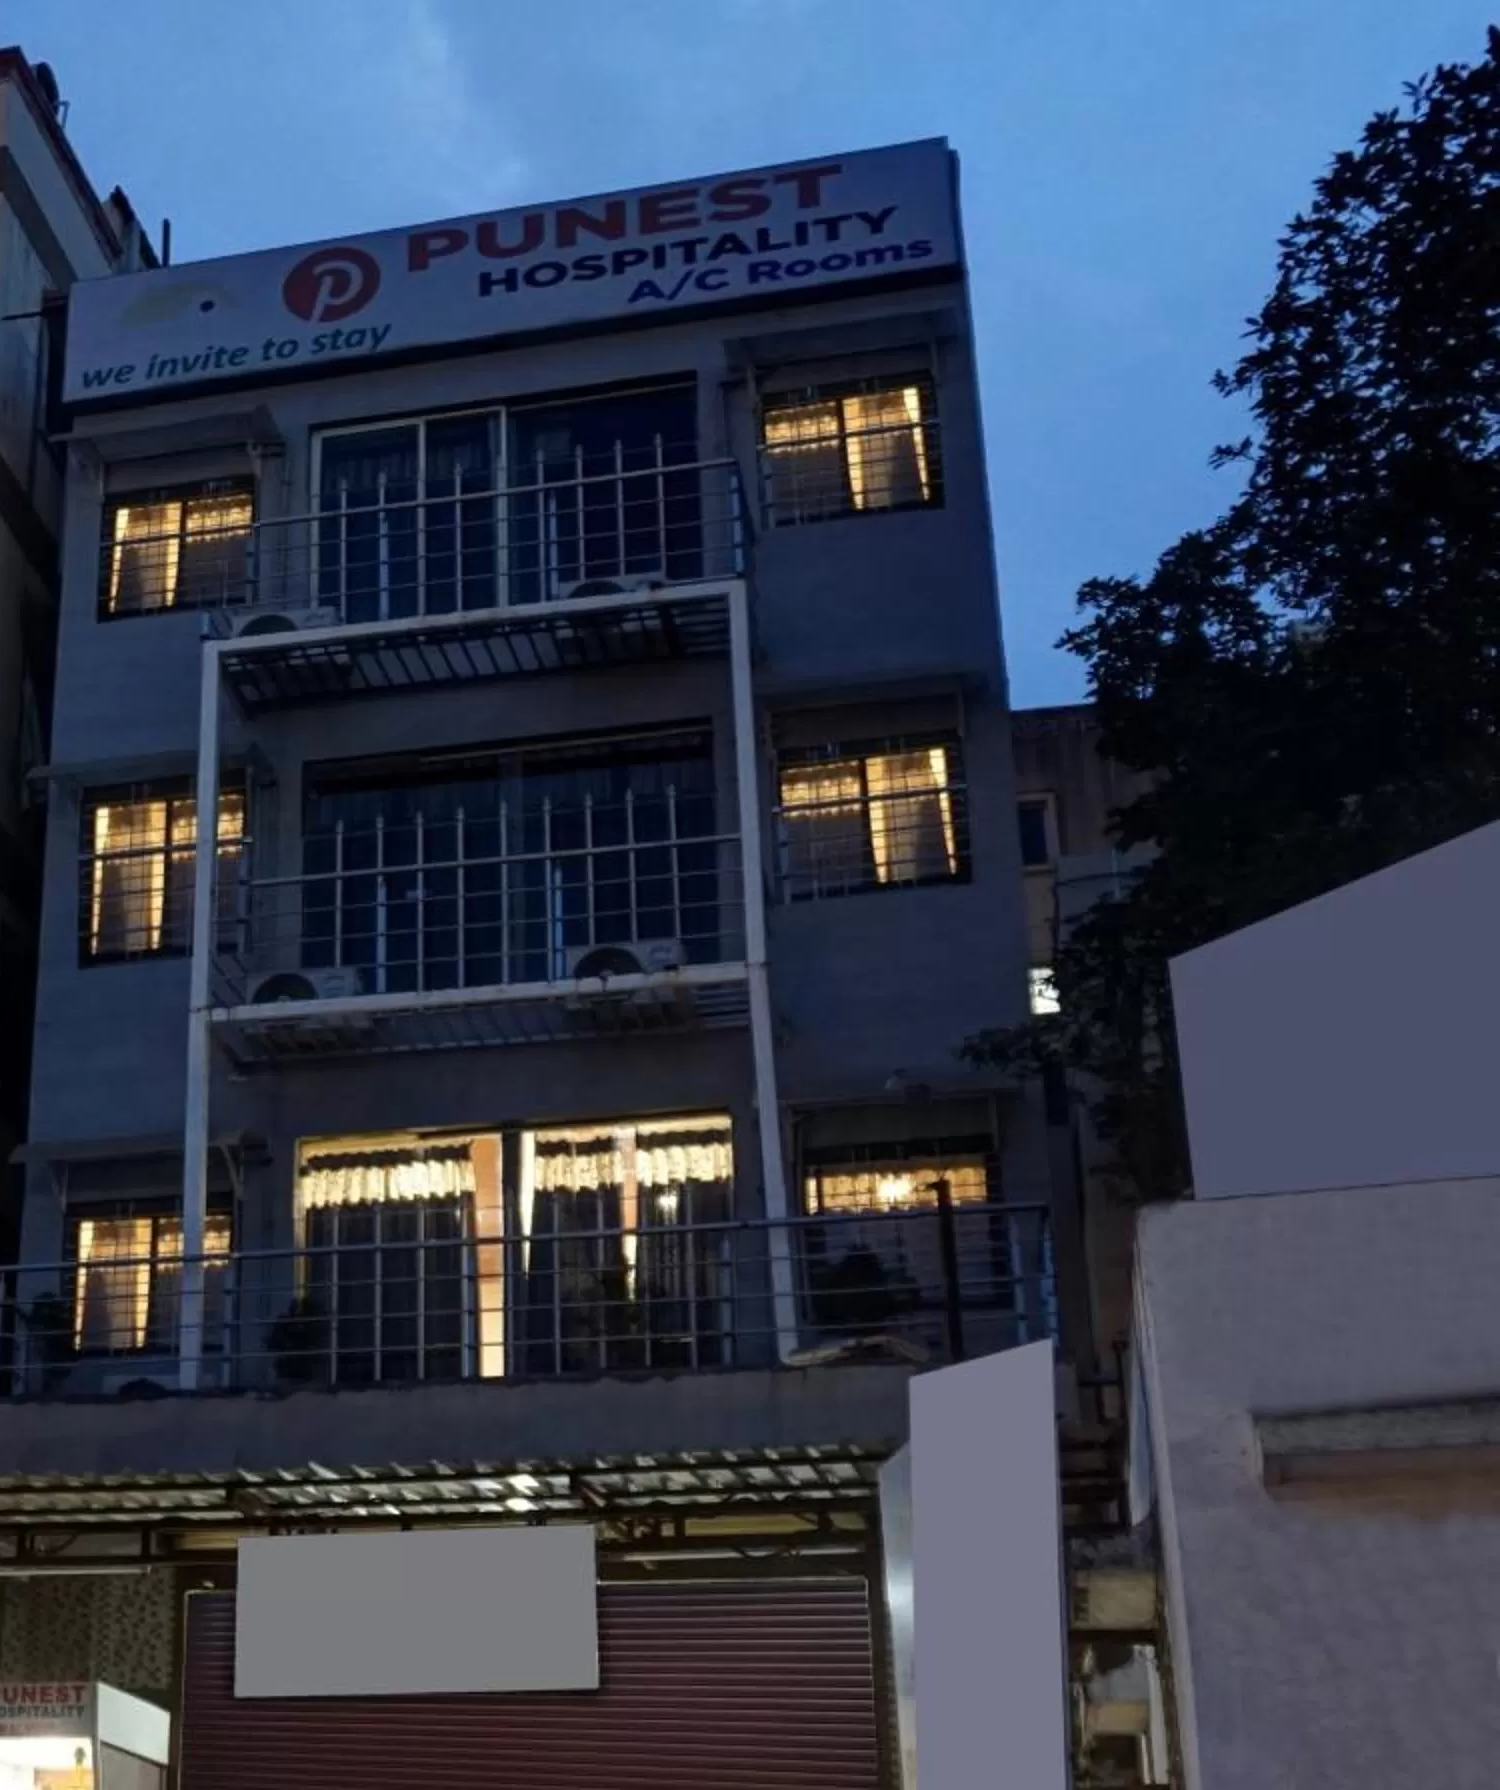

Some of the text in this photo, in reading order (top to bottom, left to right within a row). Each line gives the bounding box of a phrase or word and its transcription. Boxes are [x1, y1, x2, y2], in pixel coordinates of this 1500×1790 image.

[408, 164, 843, 273] PUNEST
[479, 206, 898, 297] HOSPITALITY
[628, 239, 933, 305] A/C Rooms
[82, 323, 392, 389] we invite to stay
